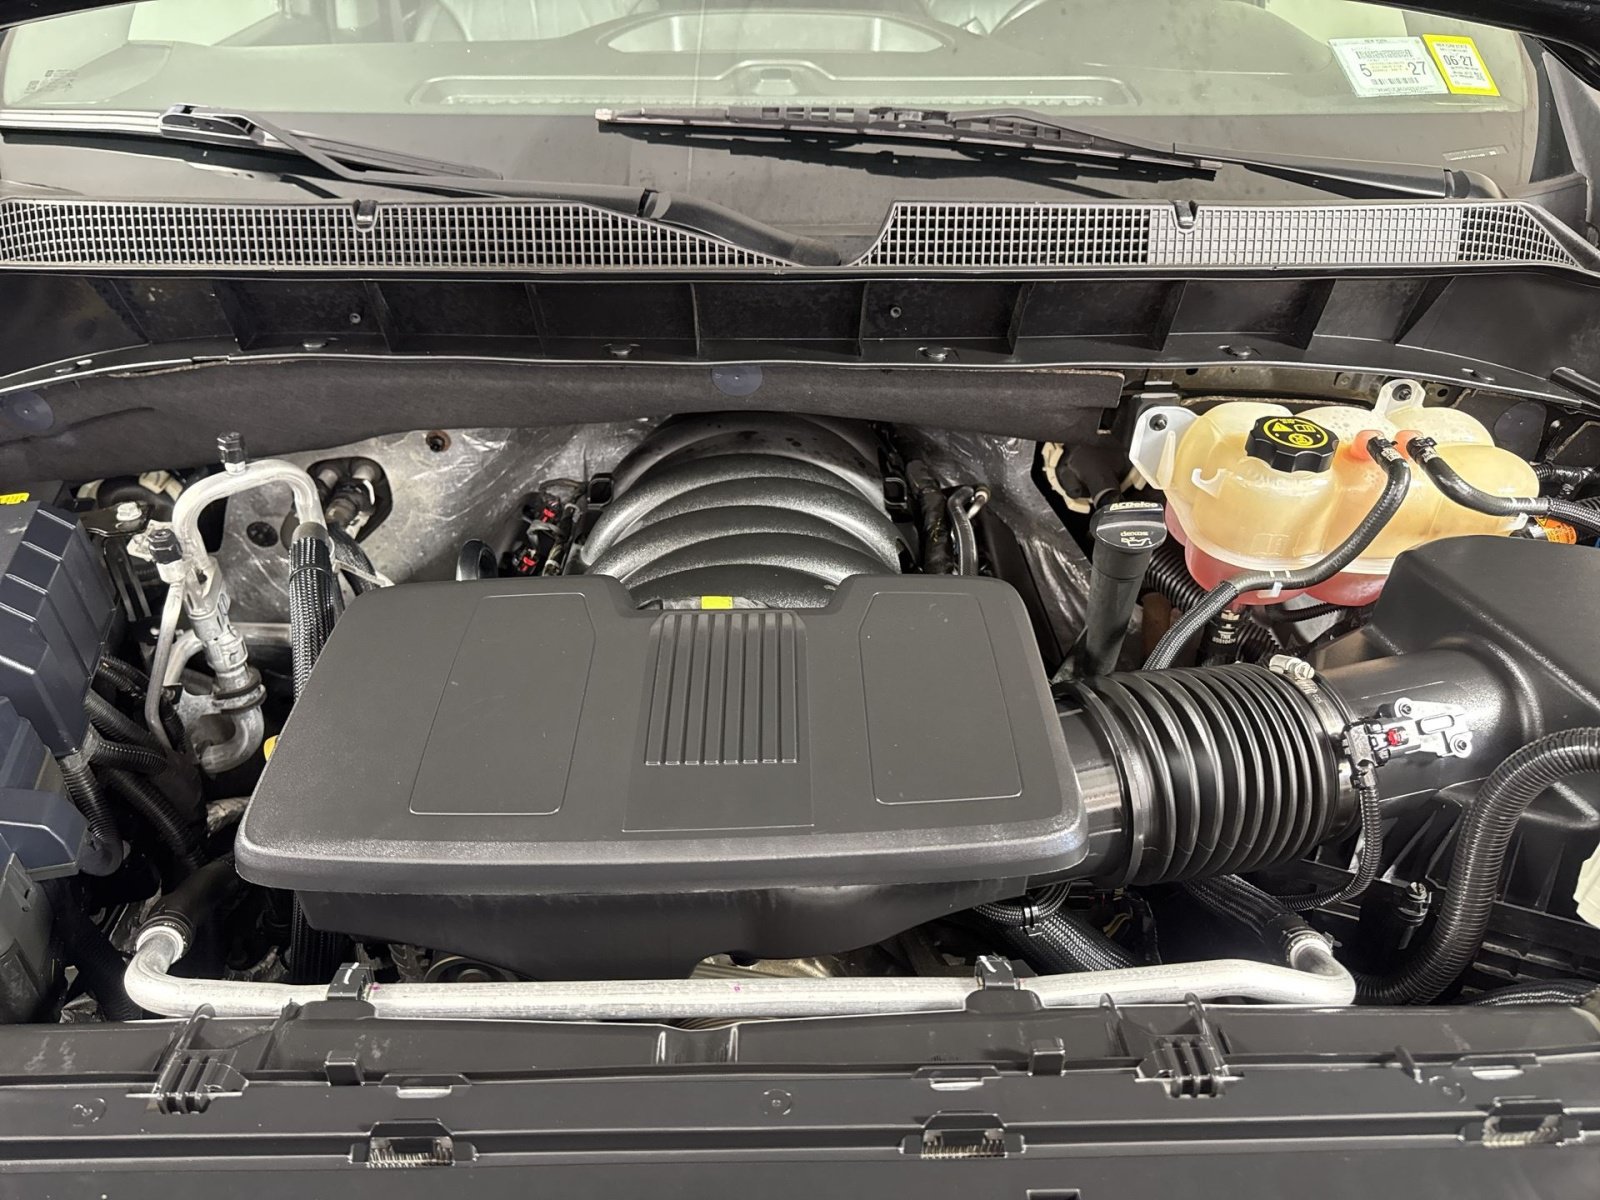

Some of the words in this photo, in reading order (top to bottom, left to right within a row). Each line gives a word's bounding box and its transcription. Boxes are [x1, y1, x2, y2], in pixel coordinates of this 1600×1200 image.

[1443, 54, 1459, 66] 06
[1460, 55, 1473, 67] 27
[1360, 63, 1373, 77] 5
[1407, 61, 1427, 76] 27
[1110, 501, 1158, 511] ACDelco
